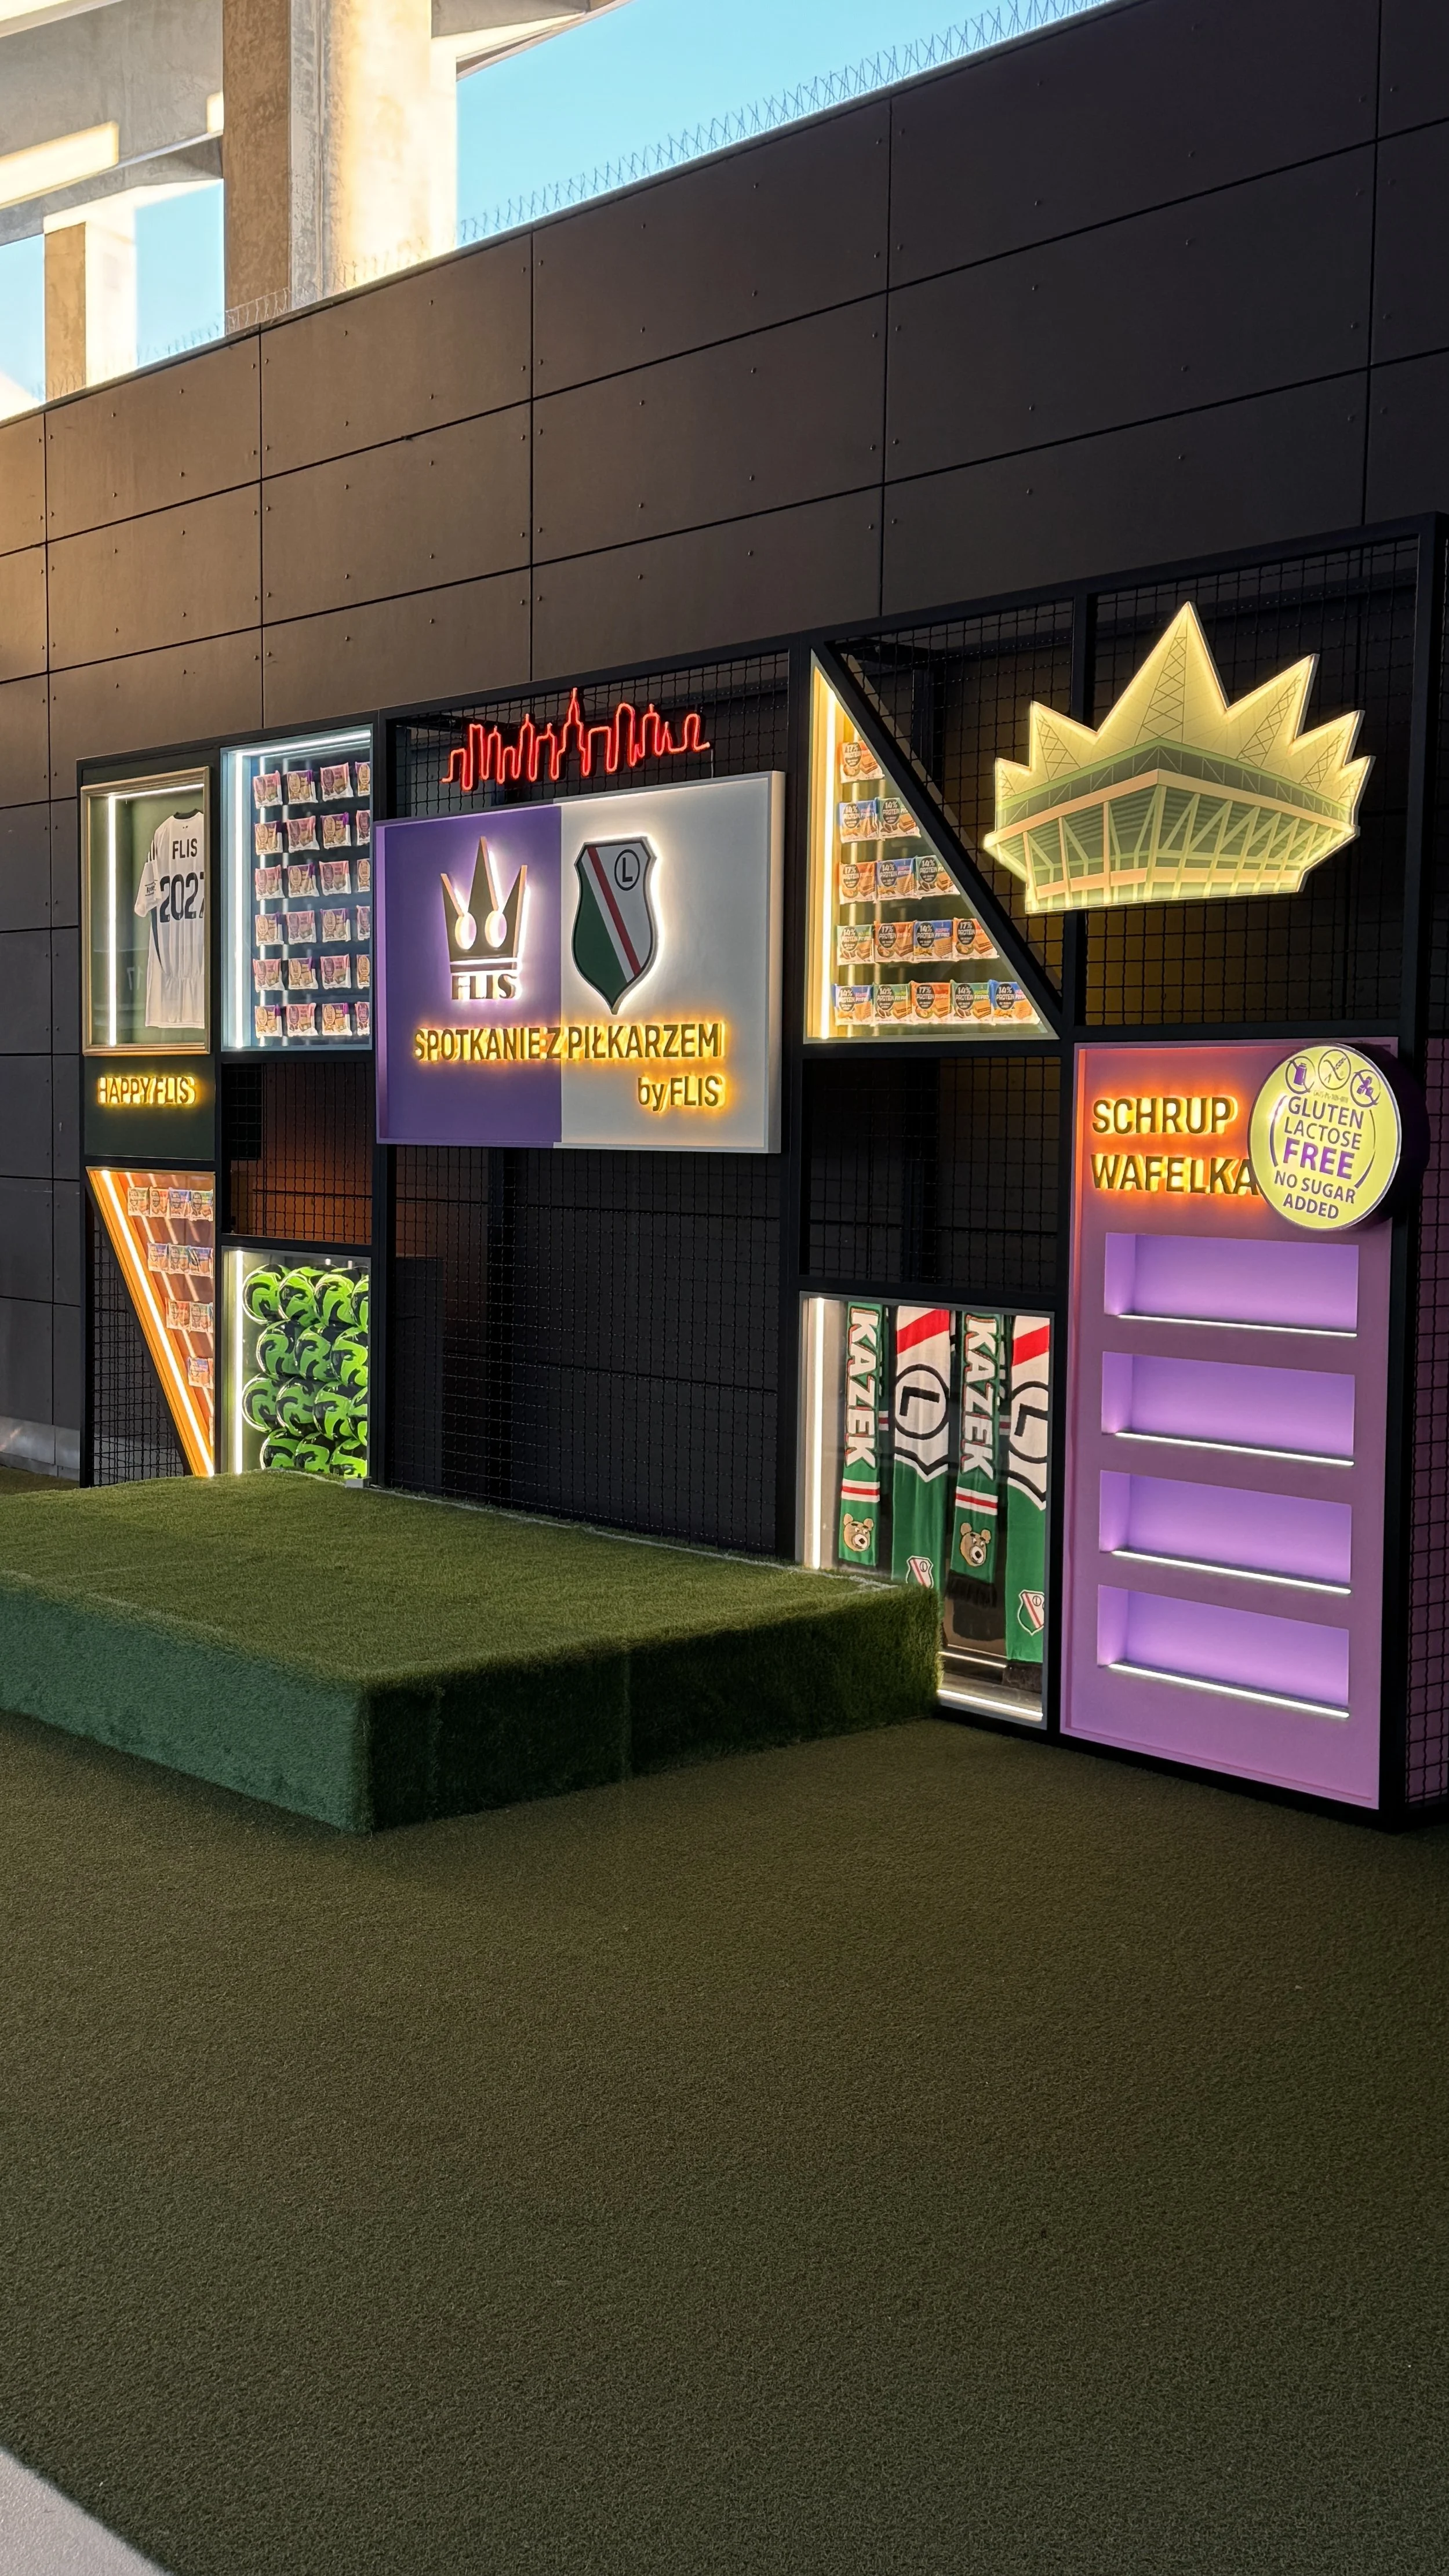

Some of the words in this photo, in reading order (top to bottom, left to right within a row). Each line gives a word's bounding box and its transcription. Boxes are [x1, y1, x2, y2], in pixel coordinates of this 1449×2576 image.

[172, 838, 198, 859] FLIS
[622, 857, 633, 882] L
[452, 974, 517, 1000] FLIS
[414, 1027, 540, 1061] SPOTKANIE
[546, 1027, 561, 1059] Z
[568, 1024, 720, 1059] PIŁKARZEM
[98, 1077, 150, 1104] HAPPY
[155, 1077, 194, 1104] FLIS
[638, 1077, 665, 1111] by
[671, 1075, 722, 1107] FLIS
[1093, 1097, 1232, 1134] SCHRUP
[1288, 1096, 1364, 1129] GLUTEN
[1284, 1116, 1362, 1151] LACTOSE
[1091, 1154, 1259, 1195] WAFELKA
[1283, 1137, 1355, 1180] FREE
[1275, 1170, 1298, 1188] NO
[1301, 1177, 1356, 1203] SUGAR
[1283, 1193, 1339, 1219] ADDED
[845, 1308, 879, 1468] KAZEK
[899, 1385, 940, 1416] L
[962, 1315, 997, 1480] KAZEK
[1014, 1403, 1048, 1437] L
